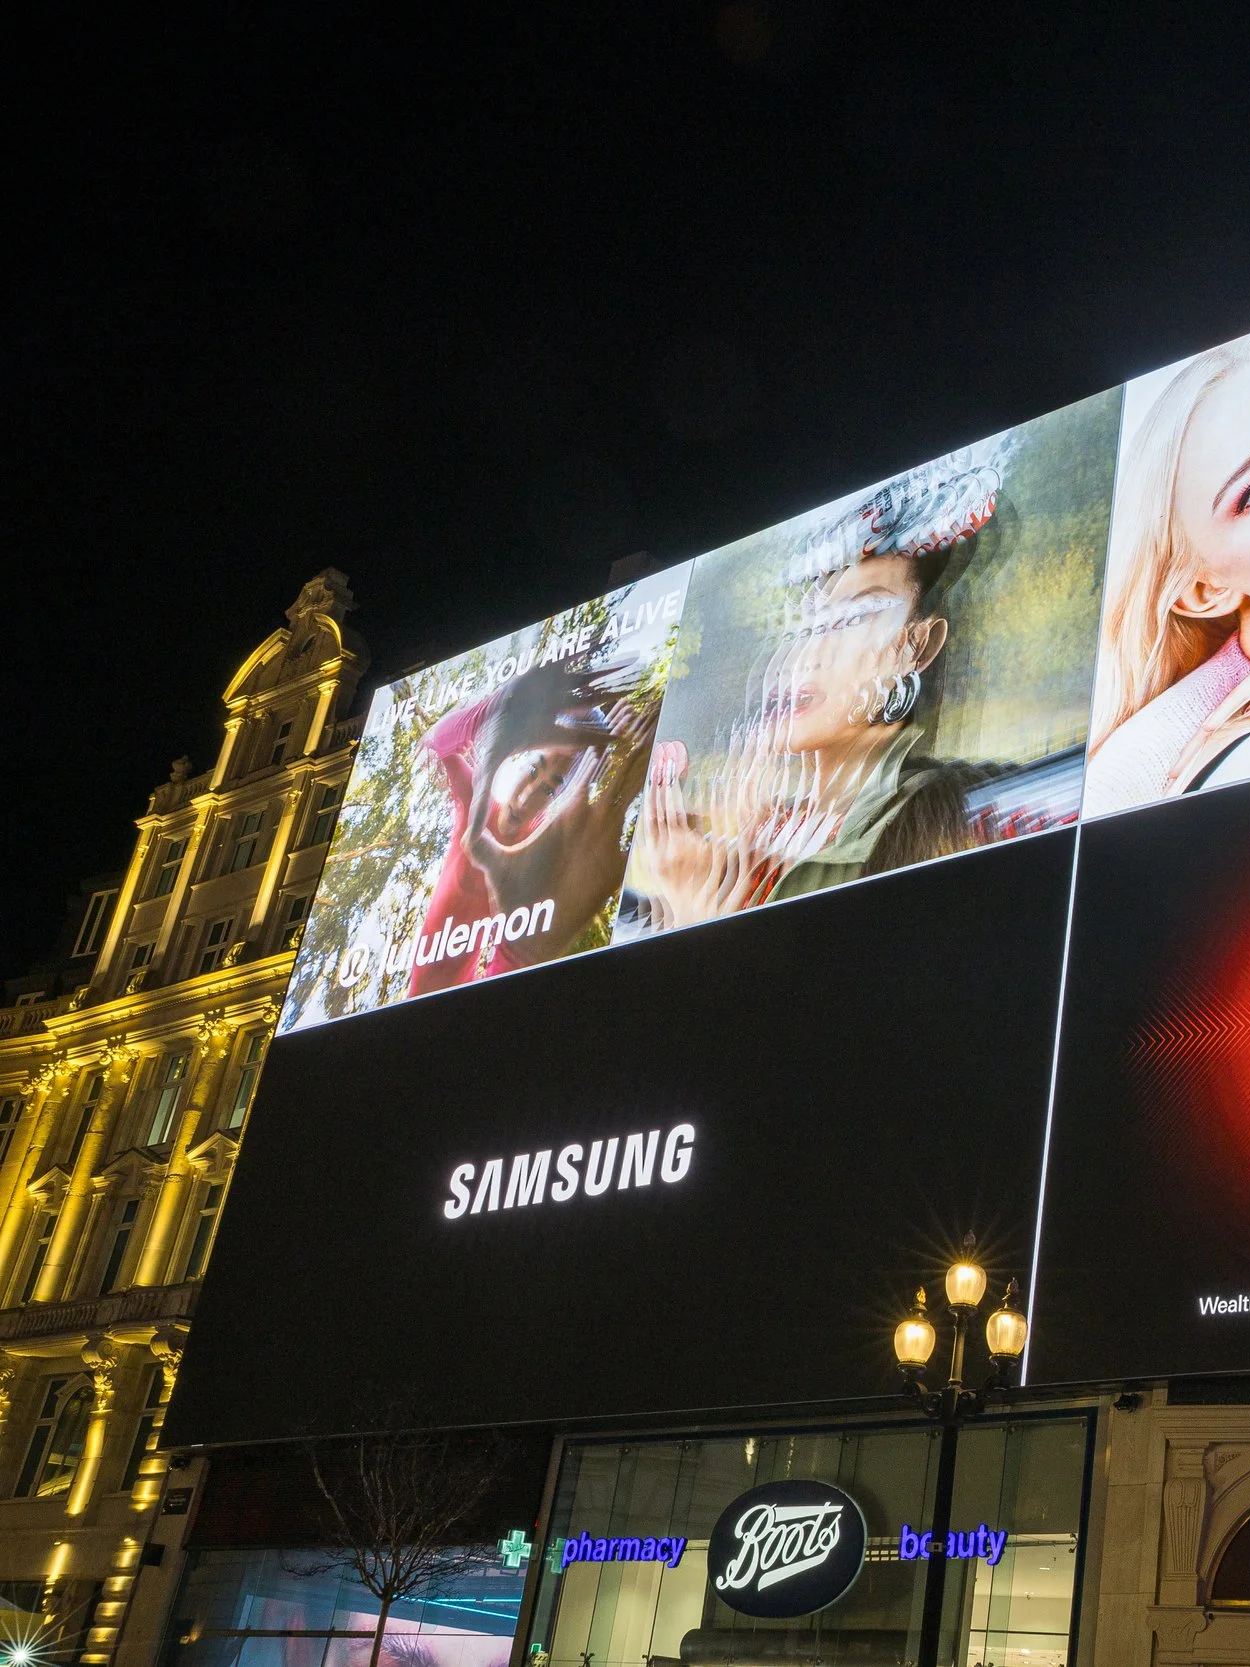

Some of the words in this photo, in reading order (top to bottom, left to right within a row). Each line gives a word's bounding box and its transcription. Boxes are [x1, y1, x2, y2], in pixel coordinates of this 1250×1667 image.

[369, 694, 418, 734] LIVE
[421, 673, 478, 711] LIKE
[484, 650, 537, 690] YOU
[539, 623, 595, 668] ARE
[599, 589, 681, 644] ALIVE
[377, 898, 555, 978] lululemon
[443, 1122, 696, 1220] SAMSUNG
[561, 1531, 687, 1569] pharmacy
[715, 1501, 844, 1592] Boots
